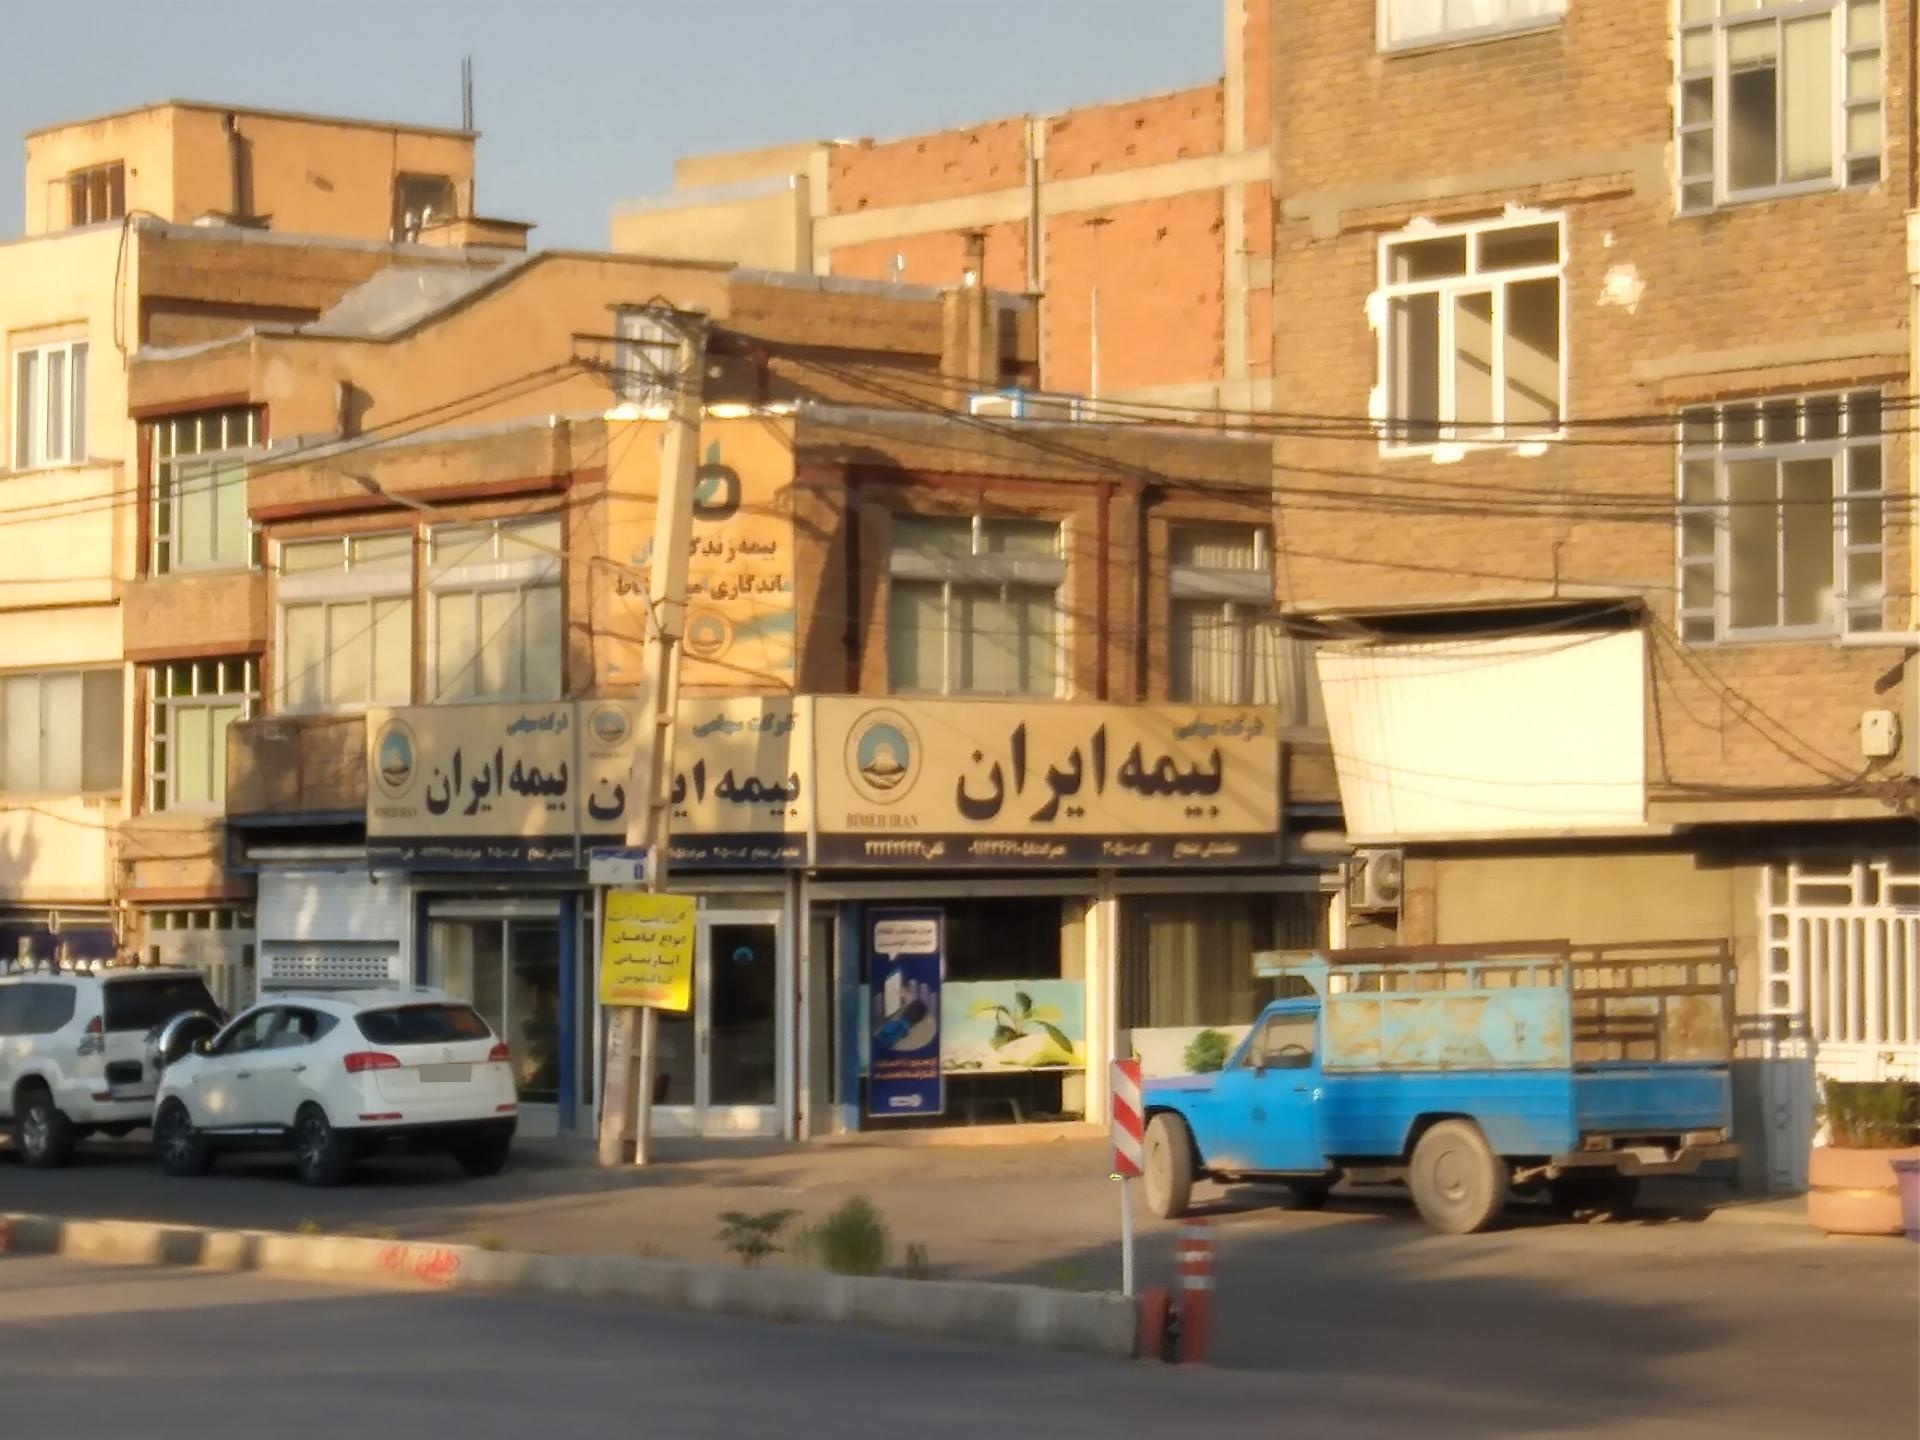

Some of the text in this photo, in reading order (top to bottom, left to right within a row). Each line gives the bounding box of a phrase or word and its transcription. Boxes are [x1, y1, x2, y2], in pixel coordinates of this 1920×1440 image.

[688, 535, 735, 563] زندگ
[426, 746, 568, 816] بیمه ایران
[715, 768, 801, 818] بیمه
[956, 719, 1223, 823] بیمه ایران
[846, 812, 918, 827] BIMEH IRAN
